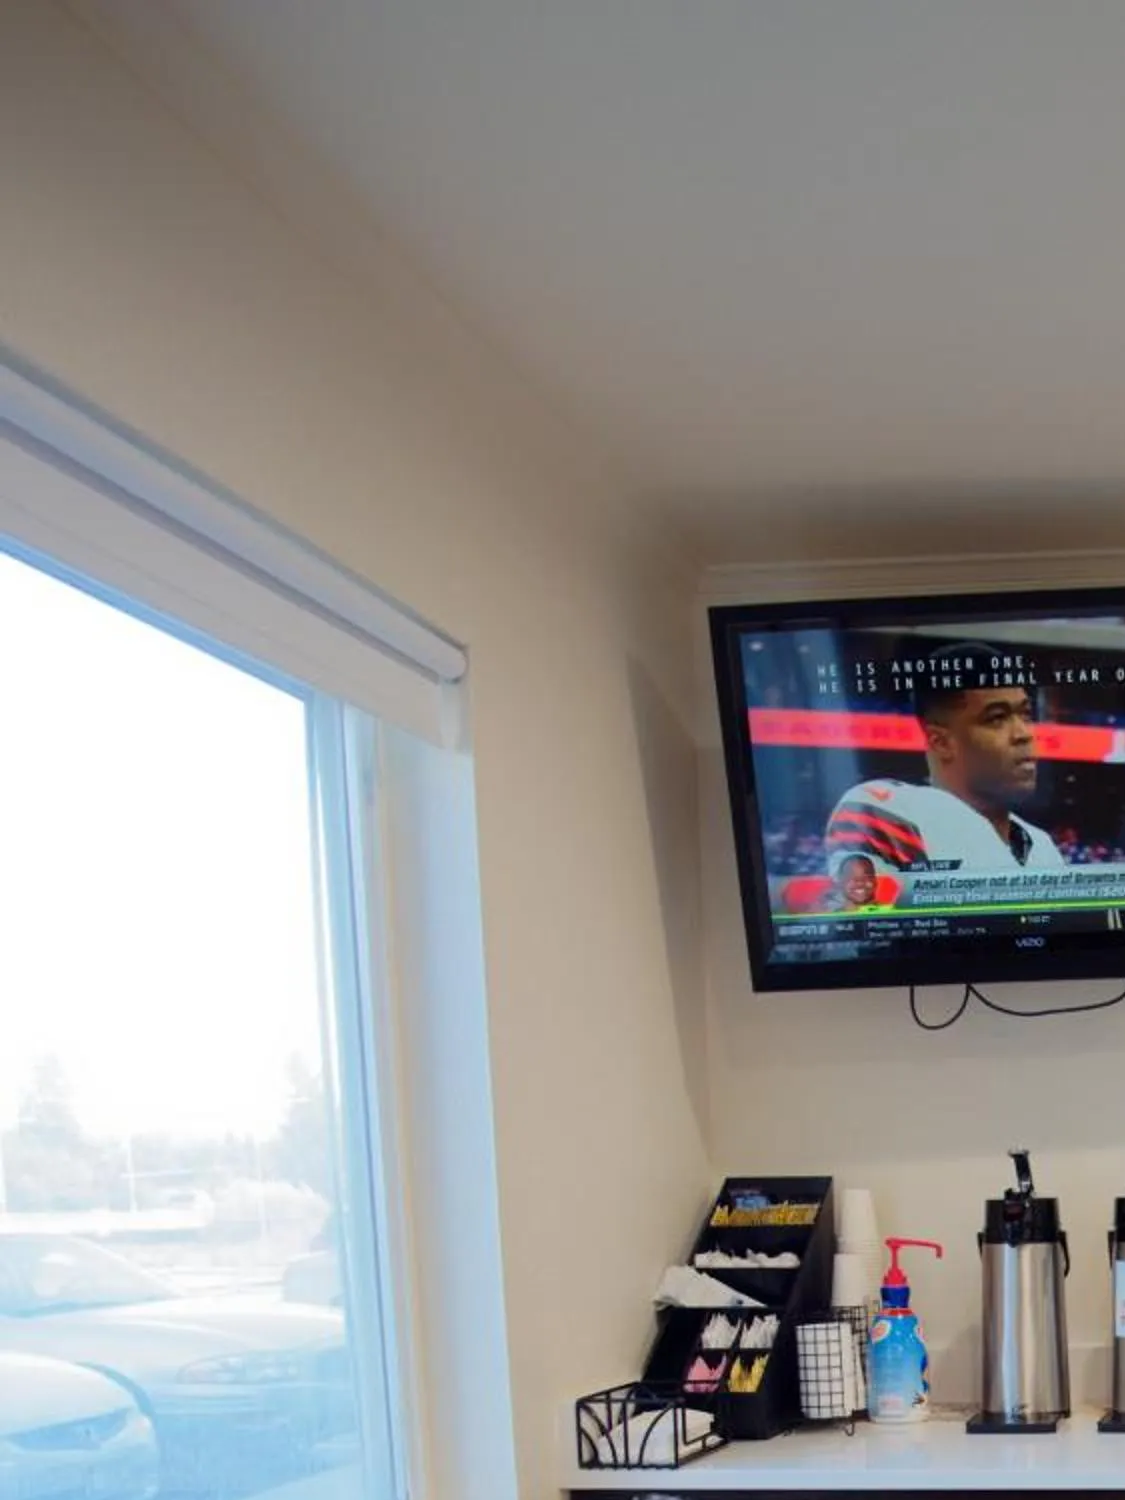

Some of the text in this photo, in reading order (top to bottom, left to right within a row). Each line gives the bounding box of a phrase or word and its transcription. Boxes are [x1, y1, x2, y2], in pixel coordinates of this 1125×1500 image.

[817, 655, 1036, 677] HE IS ANOTHER ONE.
[819, 681, 840, 694] HE
[857, 679, 877, 693] IS
[894, 677, 914, 691] IN
[930, 674, 962, 689] THE
[979, 671, 1037, 687] FINAL
[1055, 669, 1100, 683] YEAR
[914, 877, 947, 889] Amari
[950, 876, 987, 890] Cooper
[989, 875, 1007, 888] not
[1040, 873, 1058, 888] day
[1061, 872, 1073, 885] of
[1075, 872, 1116, 884] Browns
[1015, 938, 1044, 947] VIZIO
